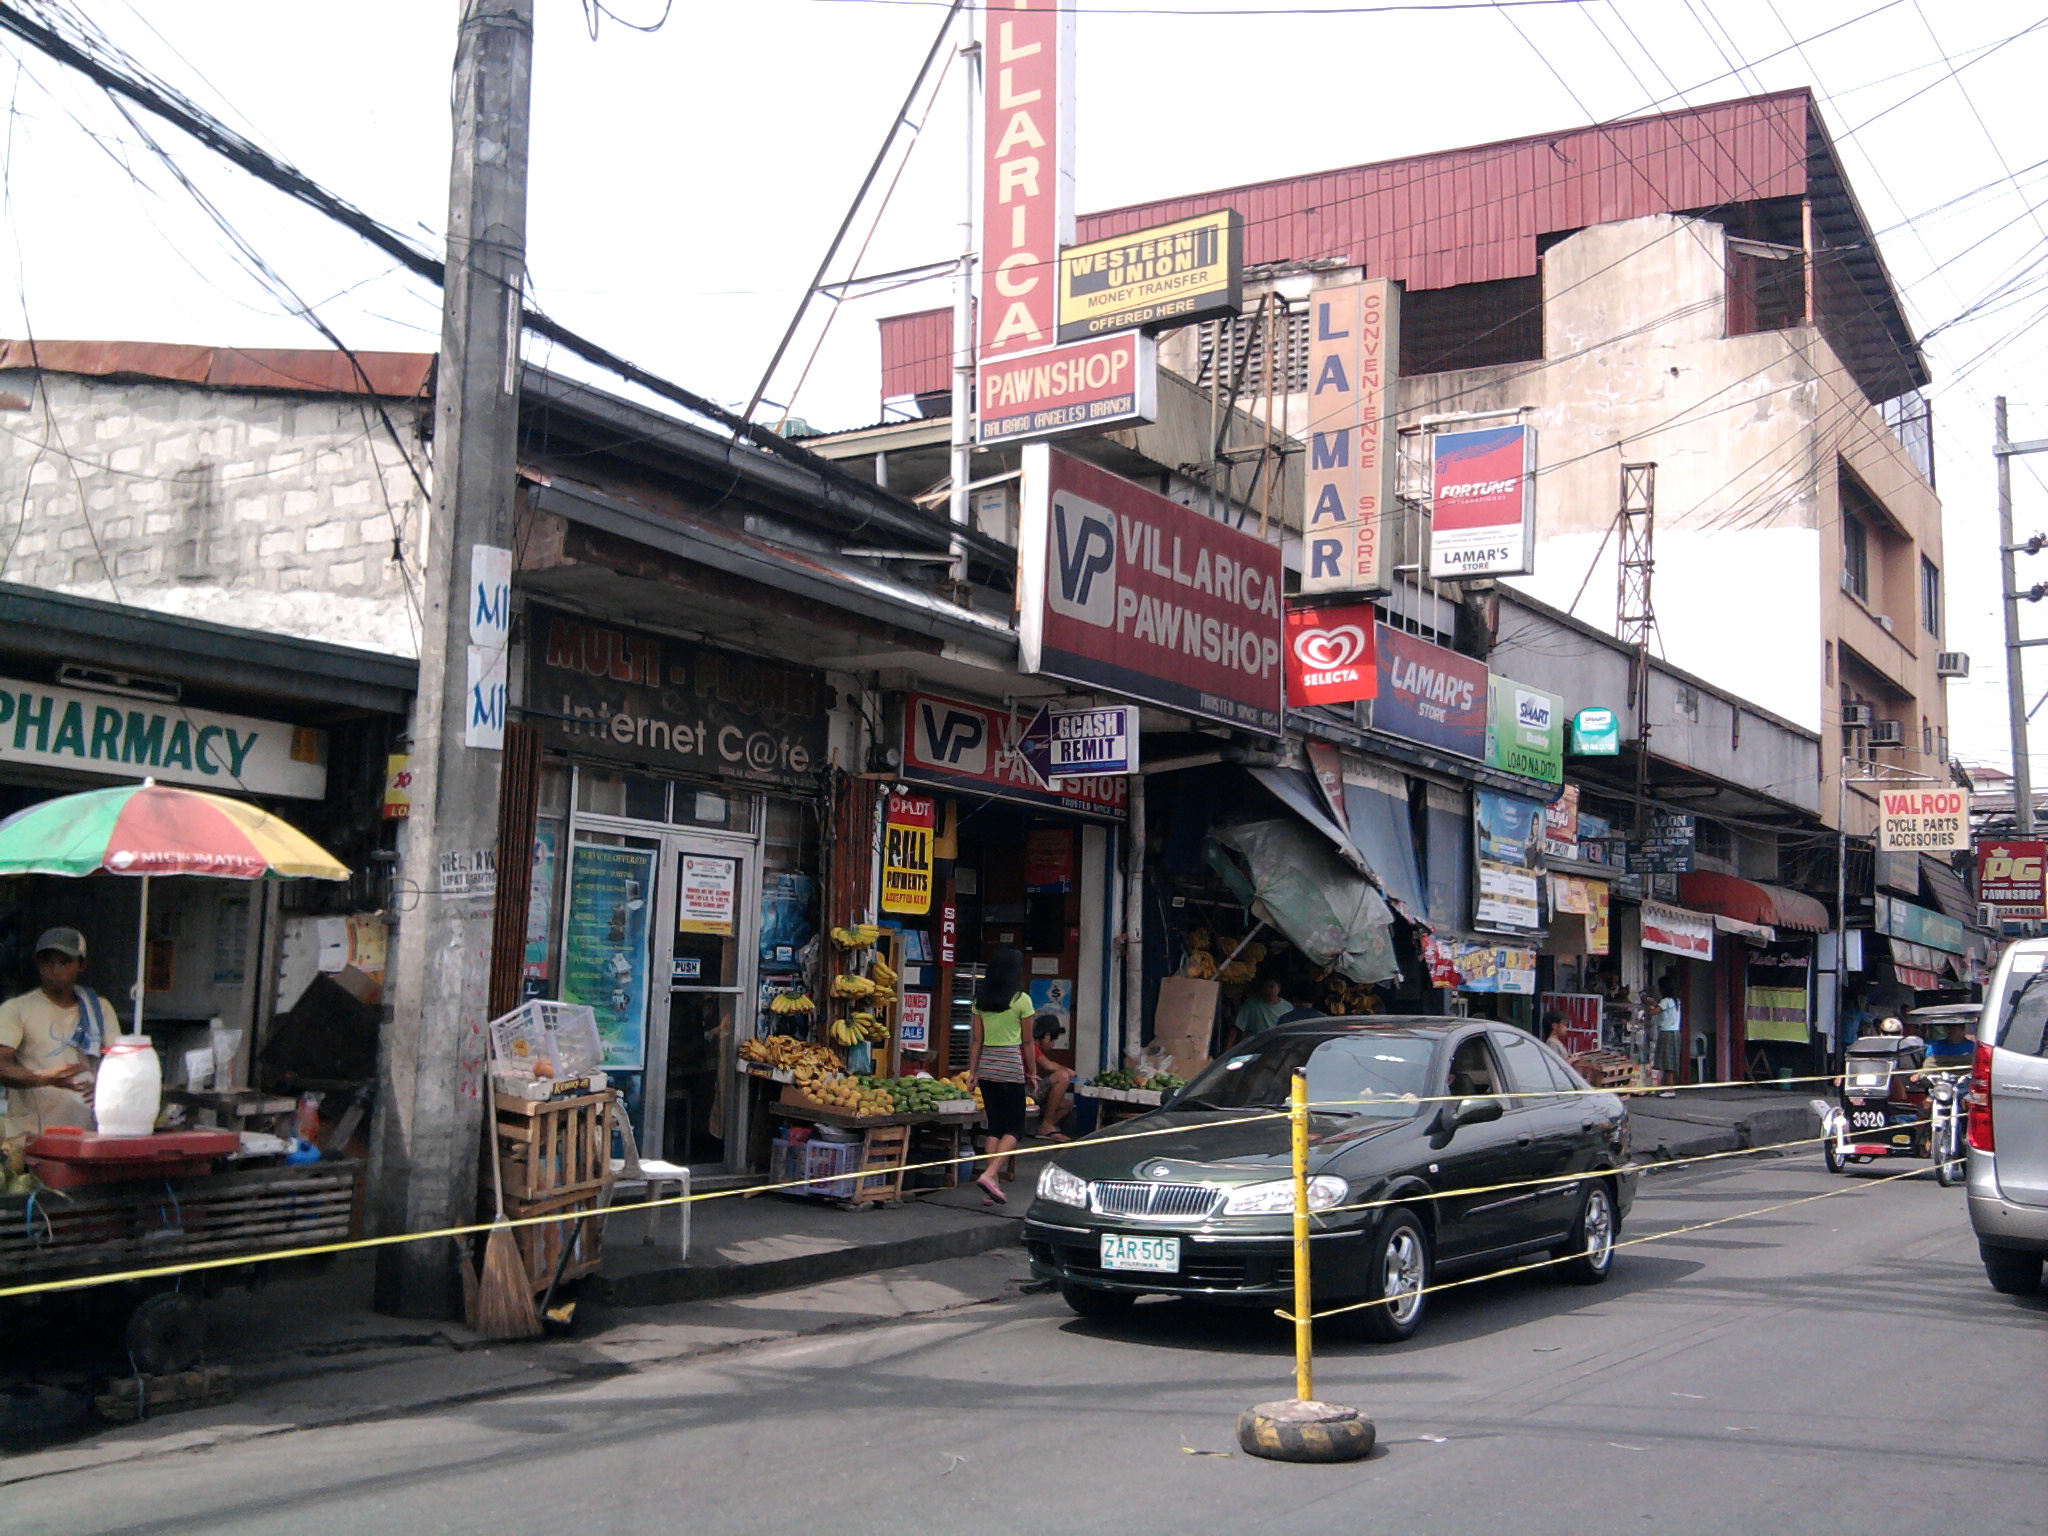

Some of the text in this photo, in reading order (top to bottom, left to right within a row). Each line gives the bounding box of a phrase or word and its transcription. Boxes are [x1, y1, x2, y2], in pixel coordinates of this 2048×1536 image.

[990, 0, 1046, 350] LLARICA
[1072, 232, 1193, 277] WESTERN
[1108, 251, 1193, 288] UNION
[1088, 271, 1208, 308] MONEY TRANSFER
[1089, 298, 1196, 331] OFFERED HERE
[986, 349, 1129, 409] PAWNSHOP
[1360, 294, 1380, 470] CONVENIENCE
[984, 396, 1131, 438] BALIBAGO (ANGELES) BRANCH
[1357, 496, 1376, 576] STORE
[1054, 503, 1116, 606] VP
[1120, 514, 1279, 619] VILLARICA
[1444, 547, 1509, 564] LAMAR'S
[1462, 561, 1489, 571] STORE
[1116, 586, 1279, 680] PAWNSHOP
[1303, 669, 1359, 687] SELECTA
[1391, 655, 1475, 712] LAMAR'S
[562, 694, 707, 756] Internet
[1059, 712, 1118, 739] GCASH
[1418, 702, 1447, 723] STORE
[1519, 702, 1550, 725] SMART
[0, 690, 259, 778] PHARMACY
[920, 702, 983, 764] VP
[1061, 738, 1116, 762] REMIT
[1507, 750, 1557, 779] LOAD NA DITO
[901, 799, 931, 817] PLDT
[1883, 793, 1962, 815] VALROD
[1886, 818, 1959, 833] CYCLE PARTS
[1889, 833, 1955, 847] ACCESORIES
[887, 828, 929, 871] BILL
[886, 870, 928, 893] PAYMENTS
[1981, 856, 2042, 881] PG
[1981, 889, 2042, 900] PAWNSHOP
[942, 907, 956, 963] SALE
[674, 962, 698, 974] PUSH
[1852, 1111, 1885, 1128] 3320
